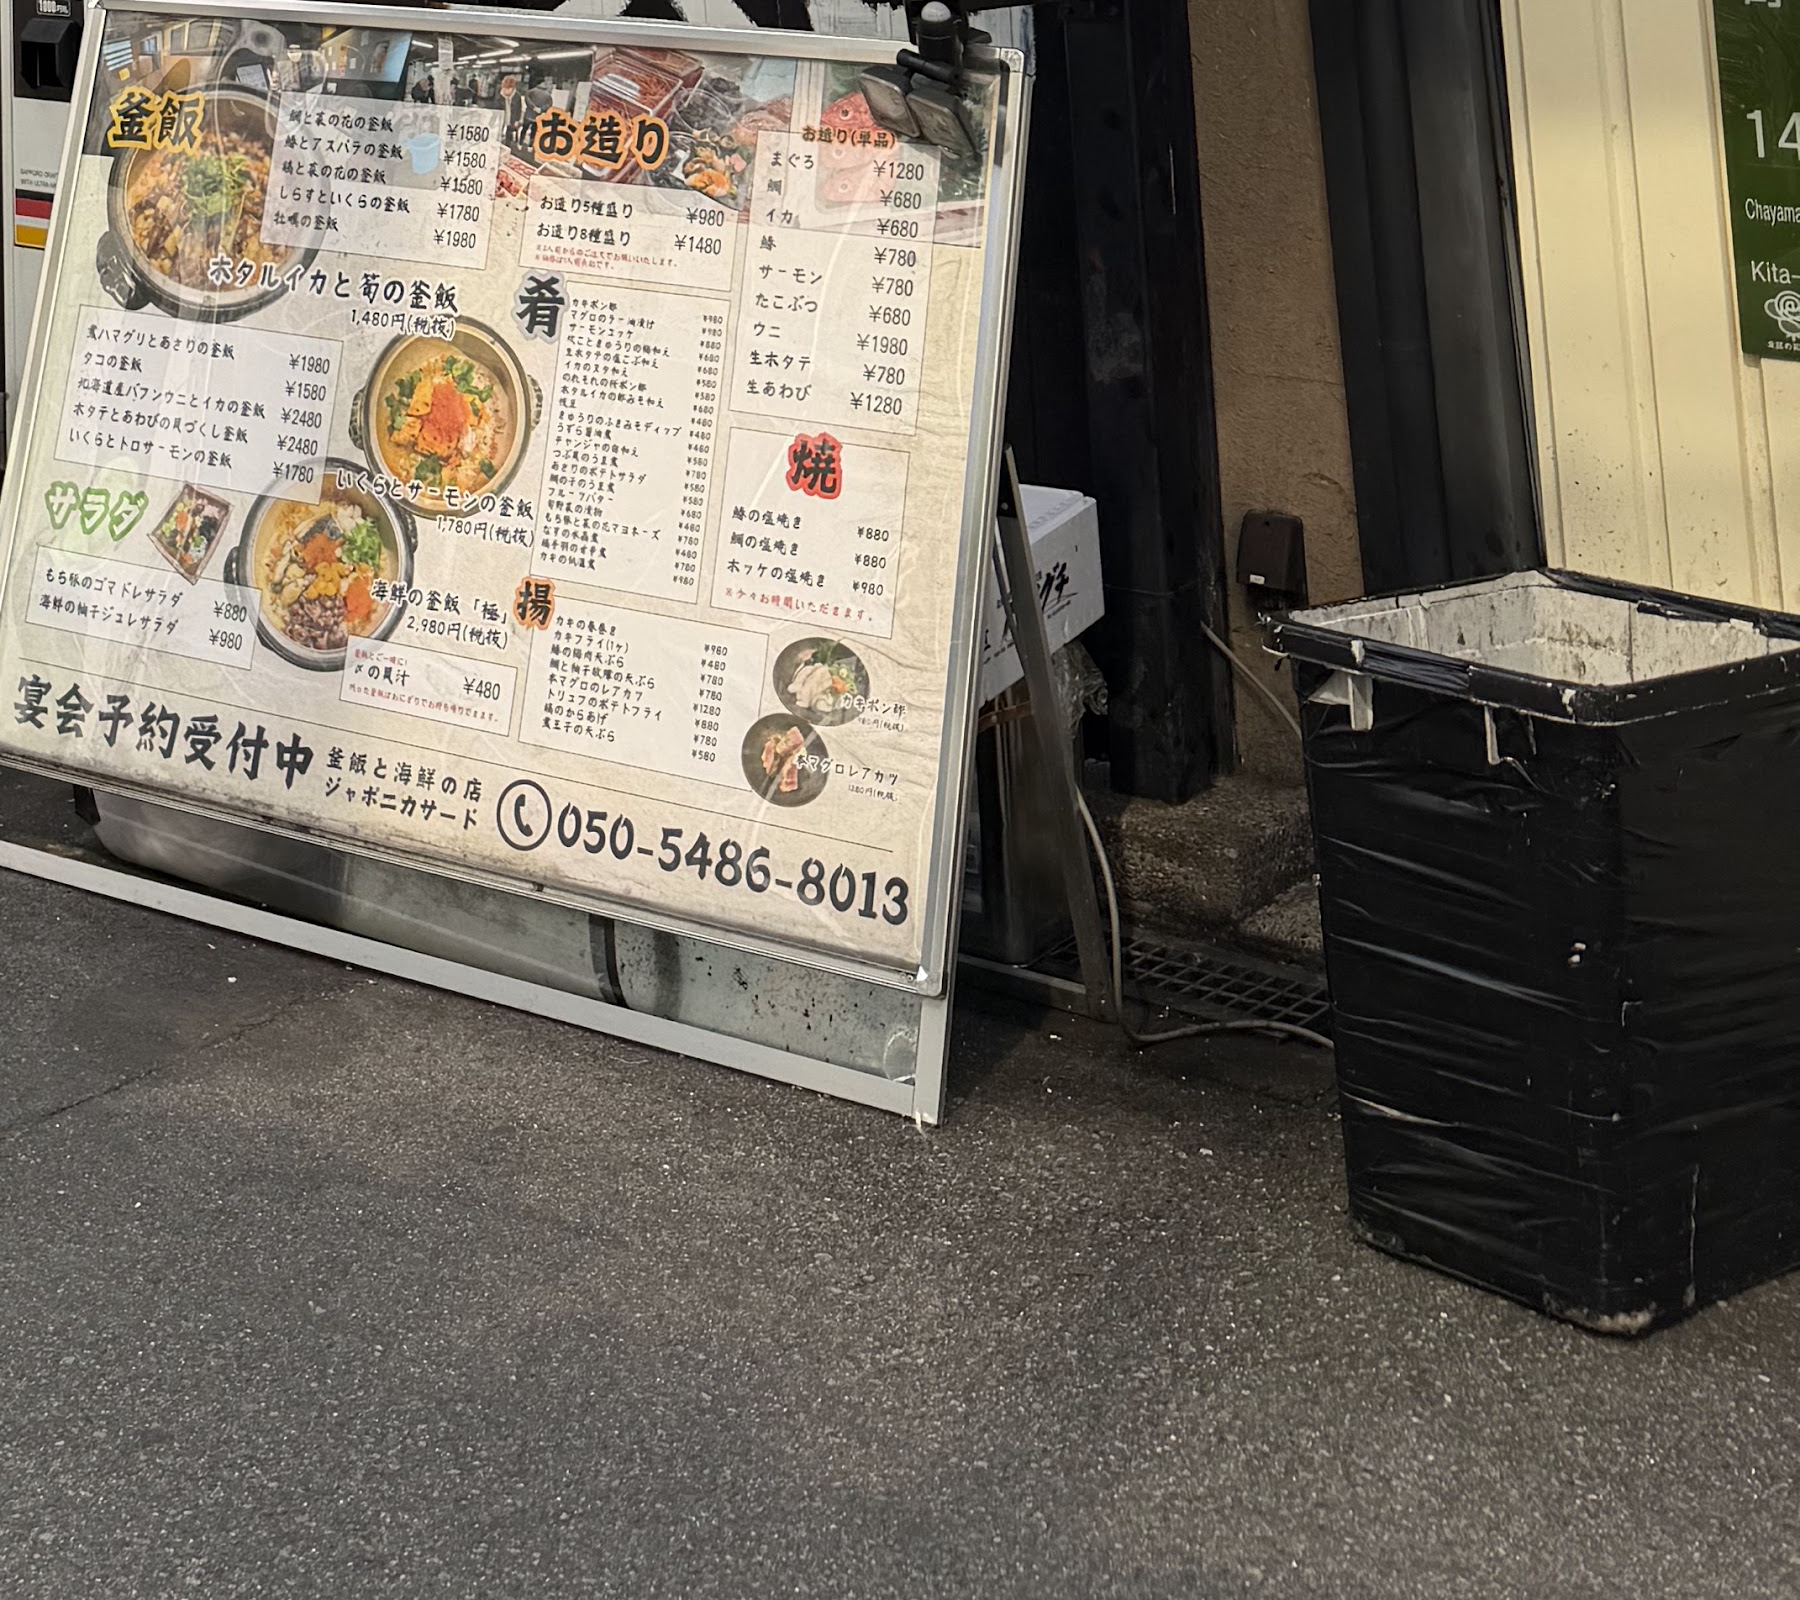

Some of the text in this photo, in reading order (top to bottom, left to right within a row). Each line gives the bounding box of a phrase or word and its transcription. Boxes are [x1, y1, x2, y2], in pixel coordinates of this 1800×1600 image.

[109, 90, 202, 152] 釜飯
[446, 123, 490, 142] ¥1580
[802, 125, 897, 149] お造り(単品)
[537, 112, 667, 165] お造り
[443, 150, 487, 169] ¥1580
[770, 152, 924, 181] まぐろ ¥1280
[440, 176, 484, 196] ¥1580
[879, 189, 922, 210] ¥680
[279, 185, 480, 223] しらすといくらの釜飯 ¥1780
[540, 196, 724, 227] お造り5種盛り ¥980
[433, 229, 477, 249] ¥1980
[536, 223, 722, 255] お造り8種盛り ¥1480
[765, 208, 919, 238] イカ ¥680
[874, 247, 916, 267] ¥780
[207, 253, 459, 314] ホタルイカと筍の釜飯
[759, 264, 914, 296] サーモン ¥780
[515, 275, 565, 338] 肴
[755, 293, 911, 326] たこぶつ ¥680
[350, 309, 456, 340] 1,480円(税抜)
[753, 322, 908, 355] ウニ ¥1980
[84, 351, 327, 401] タコの釜飯 ¥1580
[289, 353, 331, 375] ¥1980
[749, 350, 905, 385] 生ホタテ ¥780
[77, 376, 322, 429] 北海道産バフンウニとイカの釜飯 ¥2480
[746, 380, 902, 415] 生あわび ¥1280
[73, 402, 318, 456] ホタテとあわびの貝づくし釜飯 ¥2480
[69, 428, 314, 484] いくらとトロサーモンの釜飯 ¥1780
[789, 436, 840, 496] 焼
[44, 480, 149, 542] サラダ
[335, 469, 534, 521] いくらとサーモンの釜飯
[436, 516, 534, 548] 1,780円(税抜)
[856, 525, 890, 543] ¥880
[727, 558, 884, 597] ホッケの塩焼き ¥980
[854, 552, 887, 570] ¥880
[213, 601, 248, 623] ¥880
[516, 581, 553, 627] 揚
[208, 628, 243, 651] ¥980
[406, 615, 509, 649] 2,980円(税抜)
[463, 676, 502, 701] ¥480
[14, 674, 315, 792] 宴会予約受付中
[325, 744, 485, 803] 釜飯と海鮮の店
[324, 773, 483, 831] ジャポニカサード
[555, 803, 912, 928] 050-5486-8013
